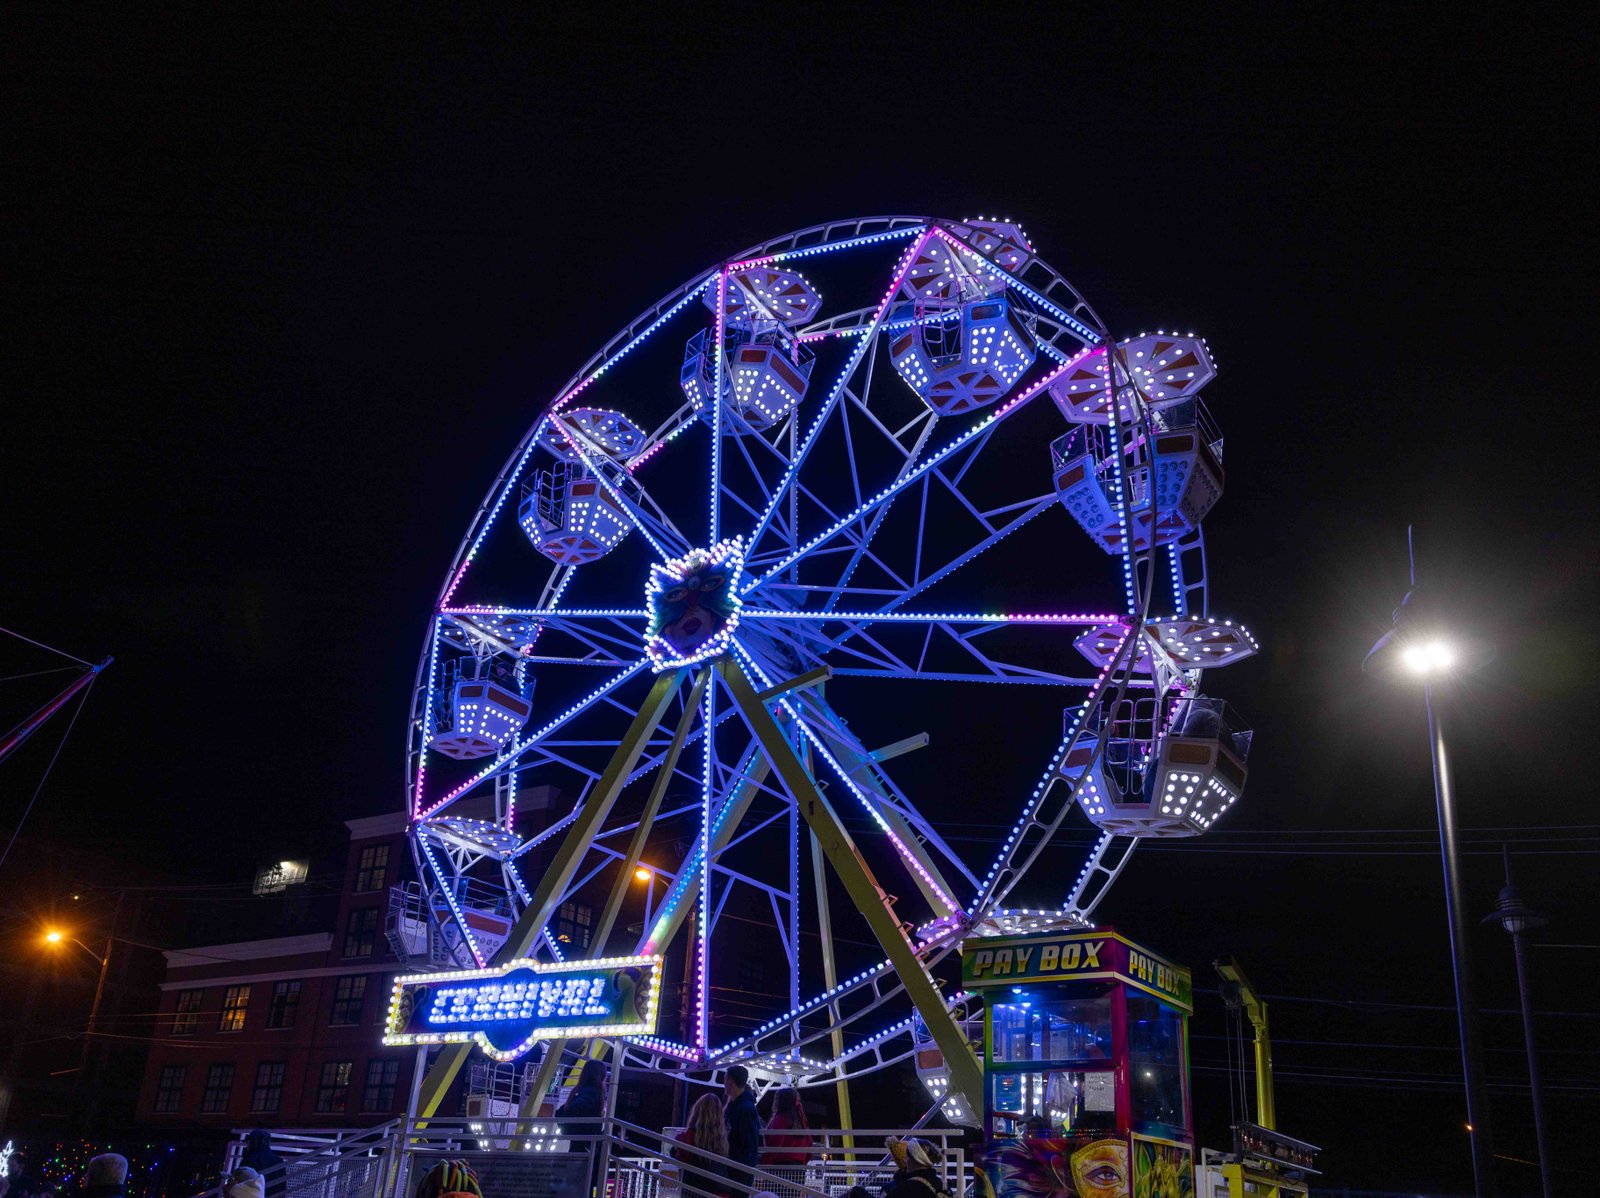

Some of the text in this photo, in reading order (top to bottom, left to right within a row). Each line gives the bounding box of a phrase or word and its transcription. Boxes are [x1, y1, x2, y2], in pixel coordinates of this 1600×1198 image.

[973, 941, 1105, 976] PAY BOX
[1129, 950, 1181, 996] PAY BOX
[428, 978, 609, 1023] CARNIVAL
